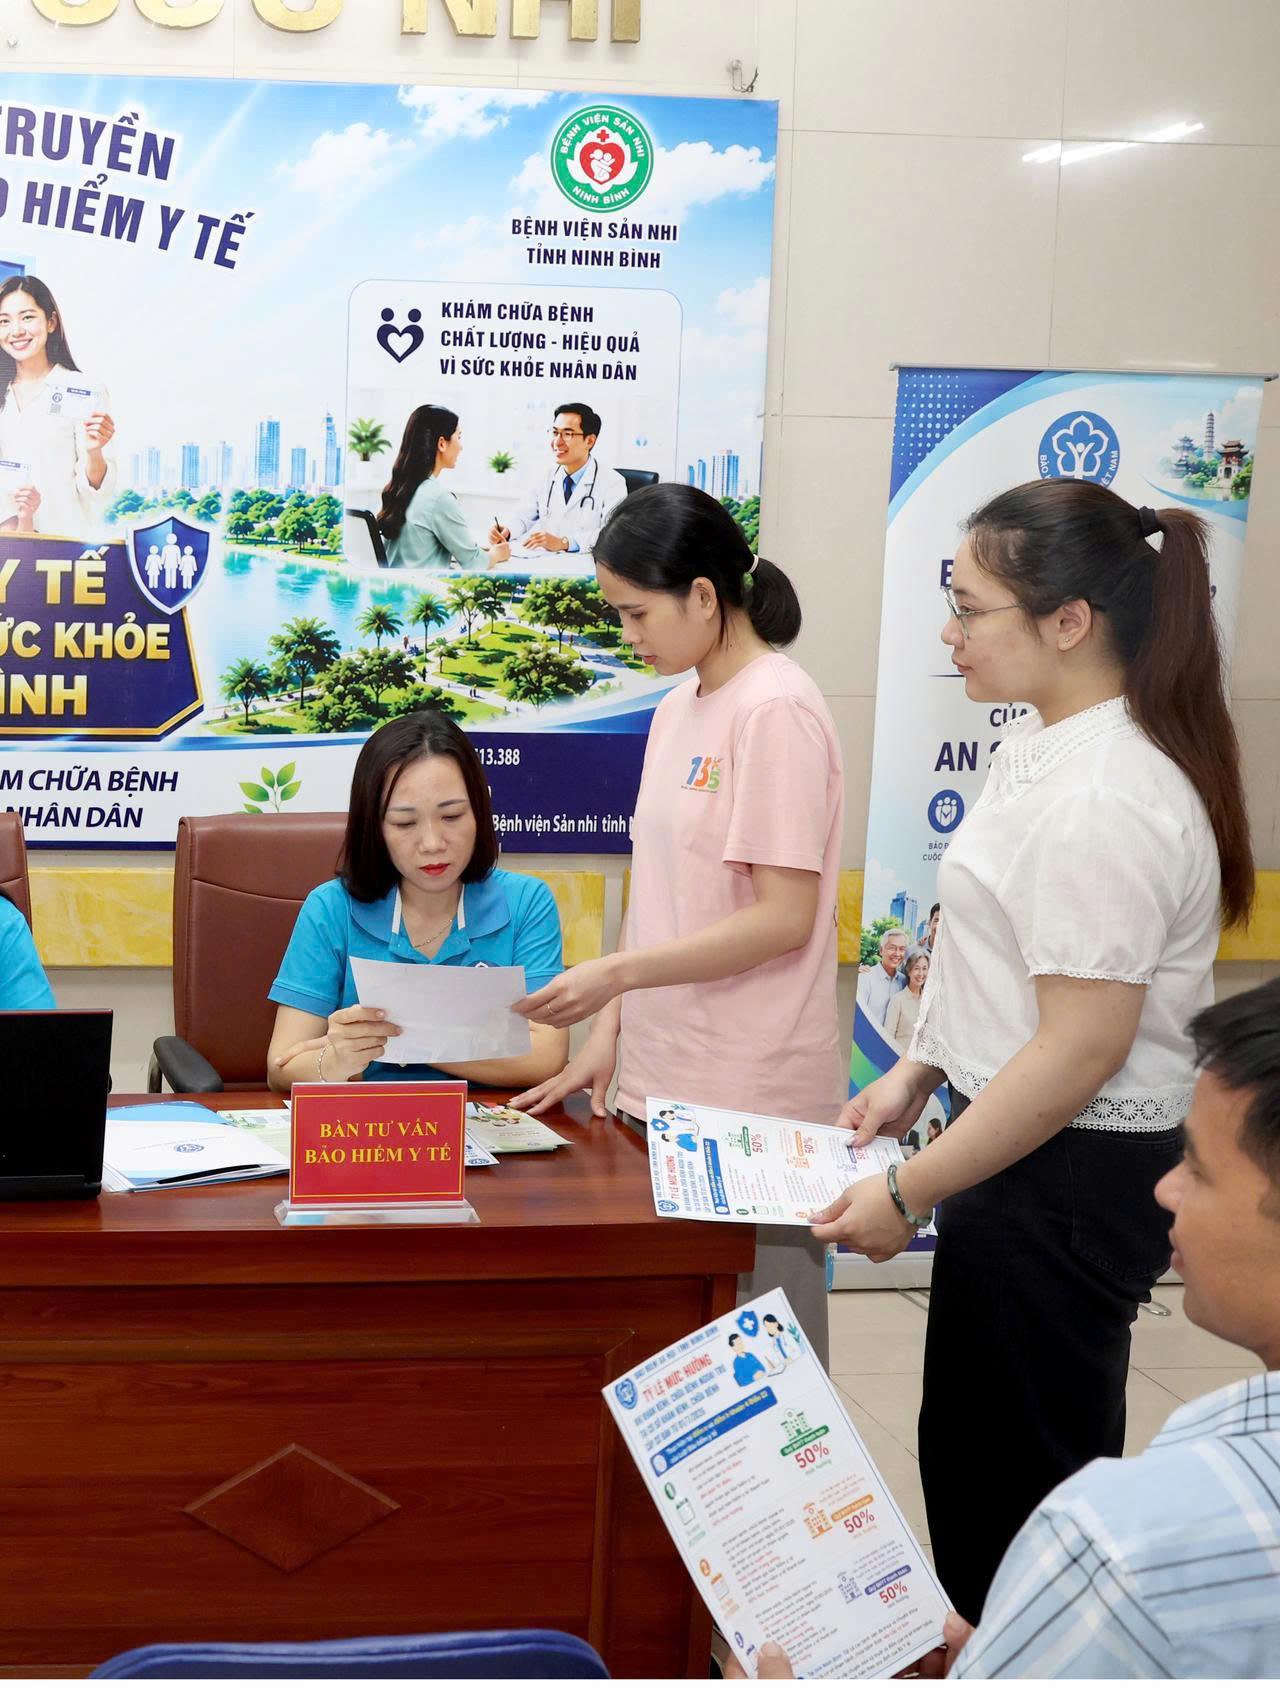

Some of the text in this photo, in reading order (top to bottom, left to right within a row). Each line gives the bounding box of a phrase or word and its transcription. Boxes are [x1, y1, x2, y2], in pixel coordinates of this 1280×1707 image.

[561, 113, 645, 157] BỆNH VIỆN SẢN NHI
[572, 186, 630, 204] NINH BÌNH
[22, 172, 144, 243] HIỂM
[158, 207, 191, 251] Y
[191, 211, 254, 270] TẾ
[512, 216, 678, 242] BỆNH VIỆN SẢN NHI
[527, 242, 661, 269] TỈNH NINH BÌNH
[441, 298, 594, 326] KHÁM CHỮA BỆNH
[441, 325, 485, 348] CHẤT
[490, 331, 546, 355] LƯỢNG
[562, 332, 602, 356] HIỆU
[606, 330, 640, 353] QUẢ
[440, 355, 637, 381] VÌ SỨC KHỎE NHÂN DÂN
[1109, 450, 1118, 471] NAM
[36, 546, 111, 606] TẾ
[54, 611, 171, 660] KHỎE
[474, 748, 520, 766] 13.388
[934, 742, 978, 771] AN
[29, 766, 102, 791] CHỮA
[108, 766, 178, 797] BỆNH
[86, 803, 143, 828] DÂN
[492, 814, 522, 836] Bệnh
[525, 814, 550, 837] viện
[553, 811, 575, 833] Sản
[578, 814, 597, 833] nhi
[602, 813, 626, 834] tỉnh
[319, 1117, 438, 1138] BÀN TƯ VẤN
[305, 1142, 452, 1164] BẢO HIỂM Y TẾ
[752, 1132, 762, 1154] 50%
[804, 1136, 815, 1155] 50%
[794, 1441, 830, 1469] 50%
[844, 1508, 876, 1534] 50%
[879, 1580, 909, 1605] 50%
